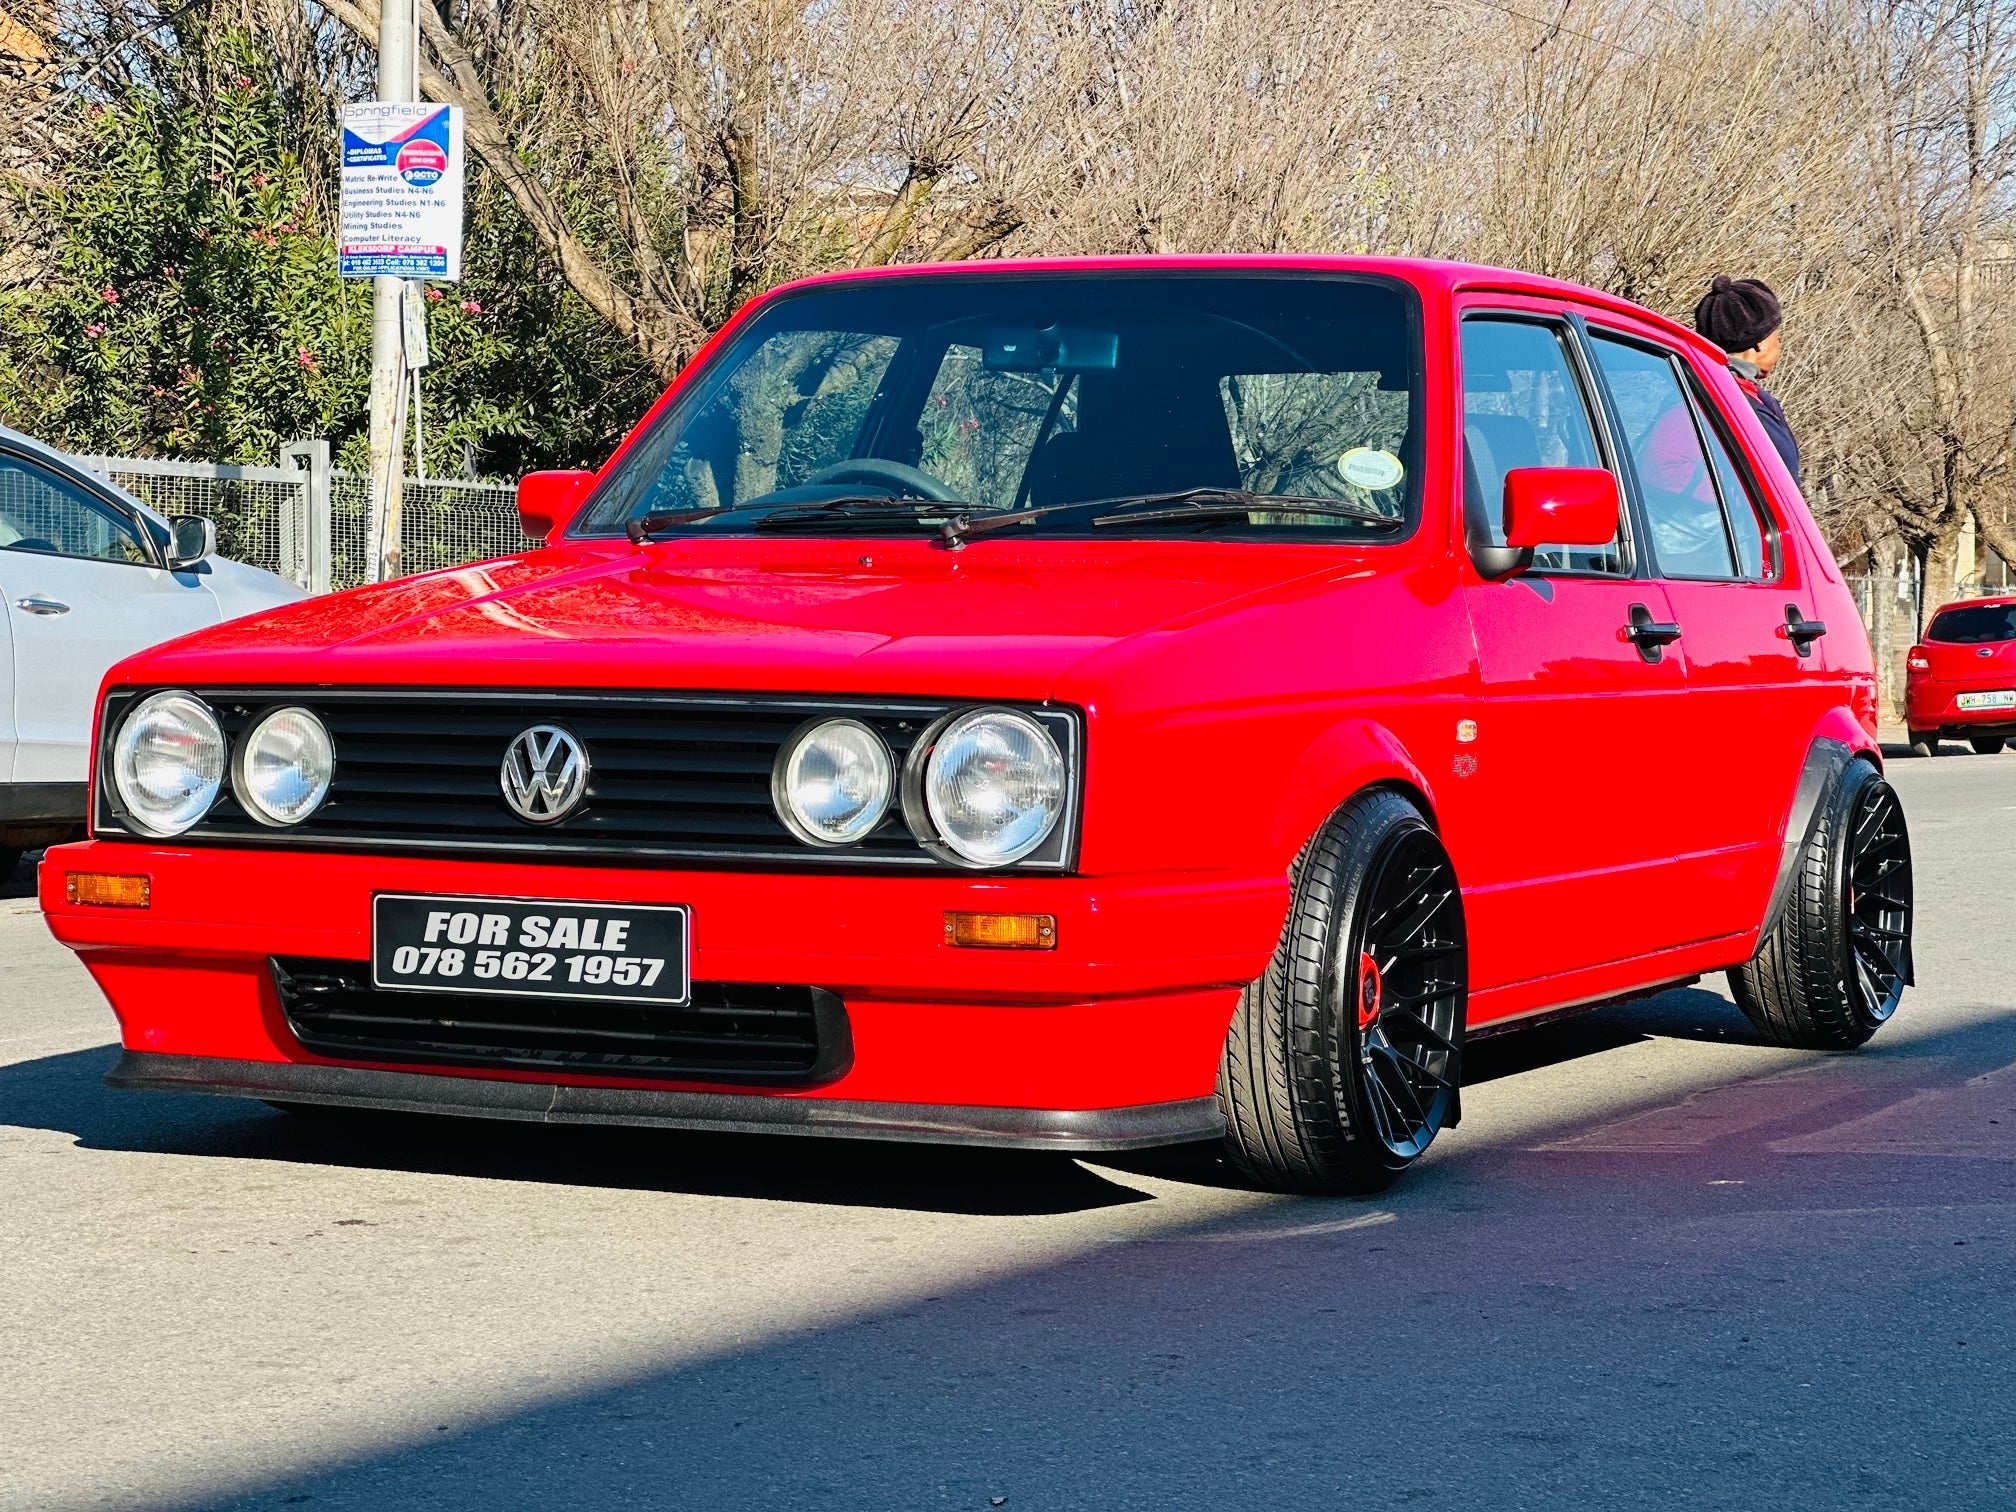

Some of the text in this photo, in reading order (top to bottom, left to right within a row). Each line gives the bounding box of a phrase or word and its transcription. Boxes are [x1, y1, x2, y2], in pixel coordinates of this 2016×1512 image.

[344, 105, 427, 117] Springfield
[367, 174, 398, 182] Re-Write
[345, 187, 374, 195] Business
[344, 200, 383, 208] Engineering
[343, 211, 364, 220] Utility
[343, 222, 403, 231] Mining Studies
[343, 234, 421, 243] Computer Literacy
[424, 911, 631, 952] FOR SALE
[392, 946, 665, 987] 078 562 1957
